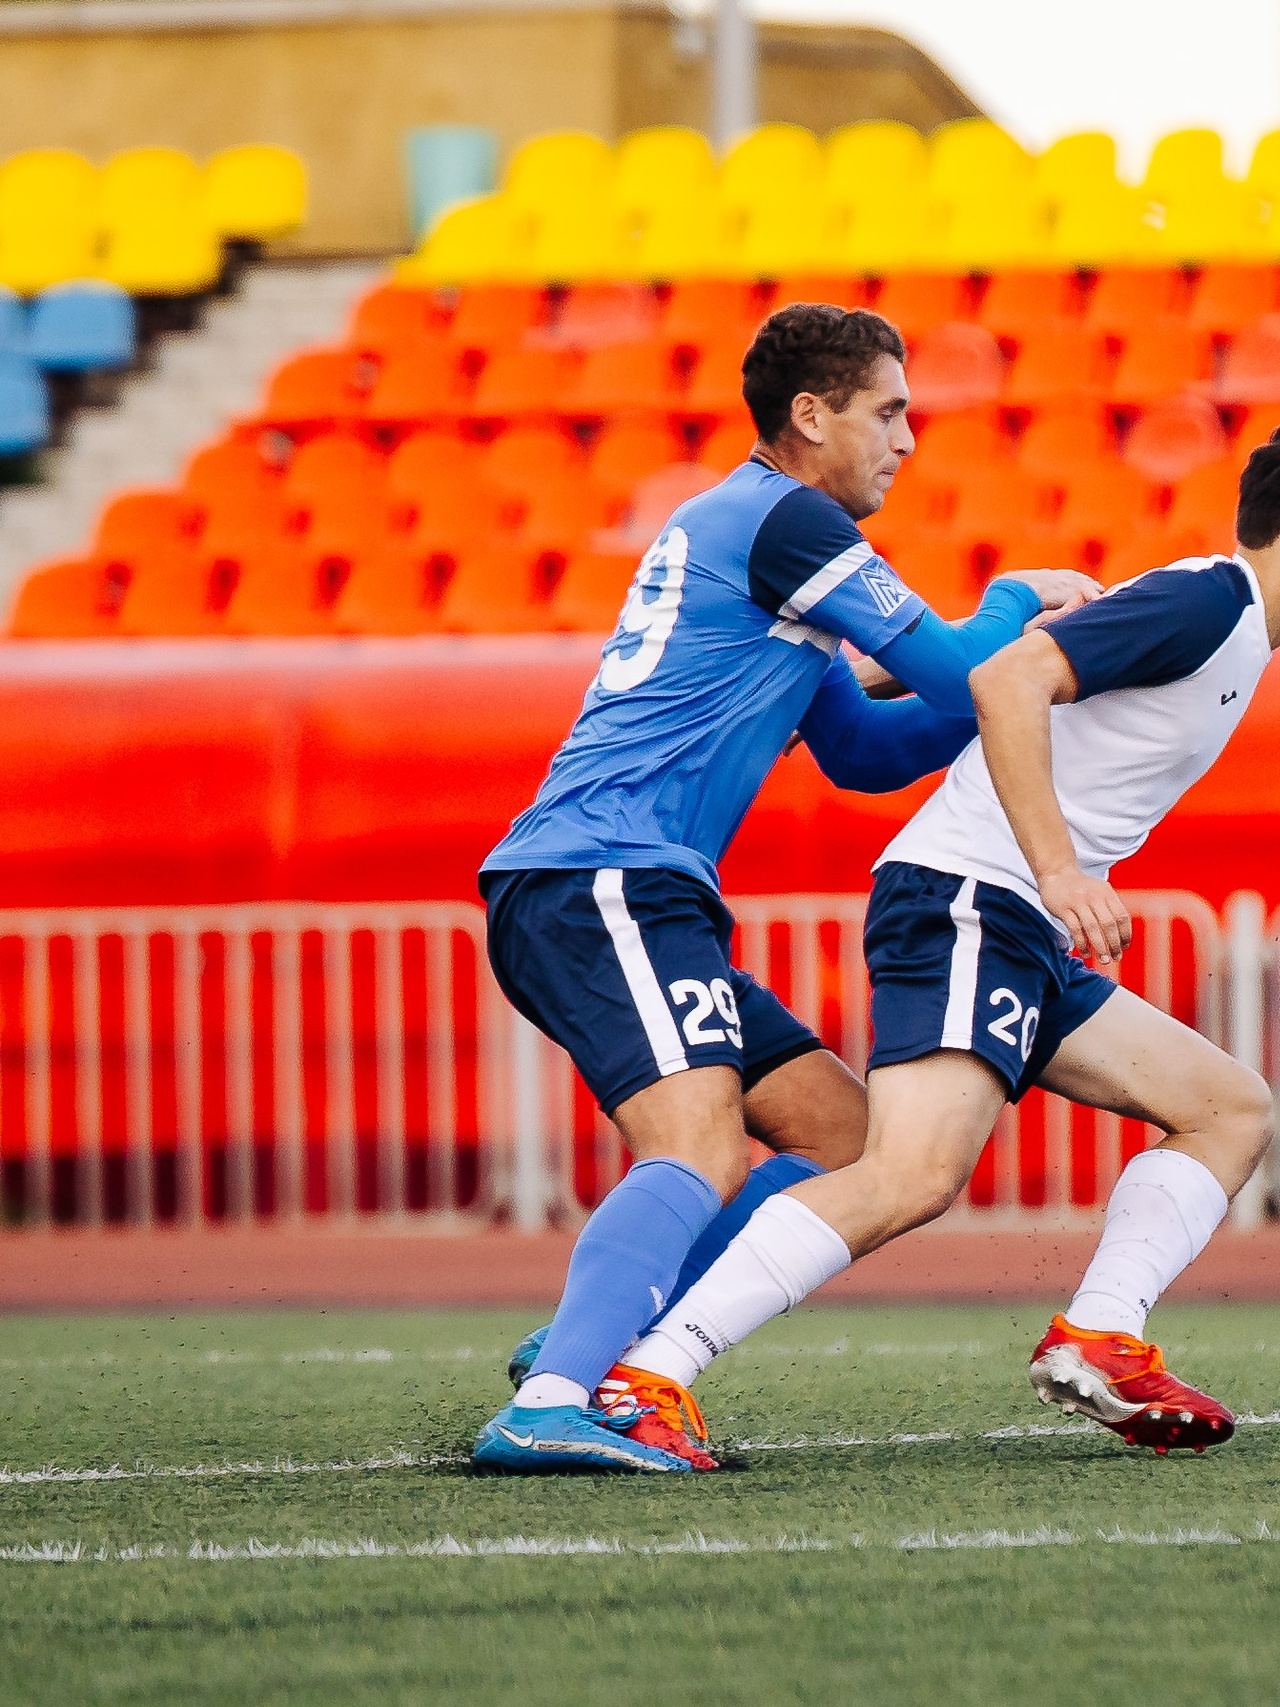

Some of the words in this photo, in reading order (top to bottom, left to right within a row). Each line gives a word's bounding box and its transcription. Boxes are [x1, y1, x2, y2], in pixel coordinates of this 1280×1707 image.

[602, 525, 689, 692] 9
[668, 978, 744, 1050] 29
[987, 987, 1040, 1063] 20
